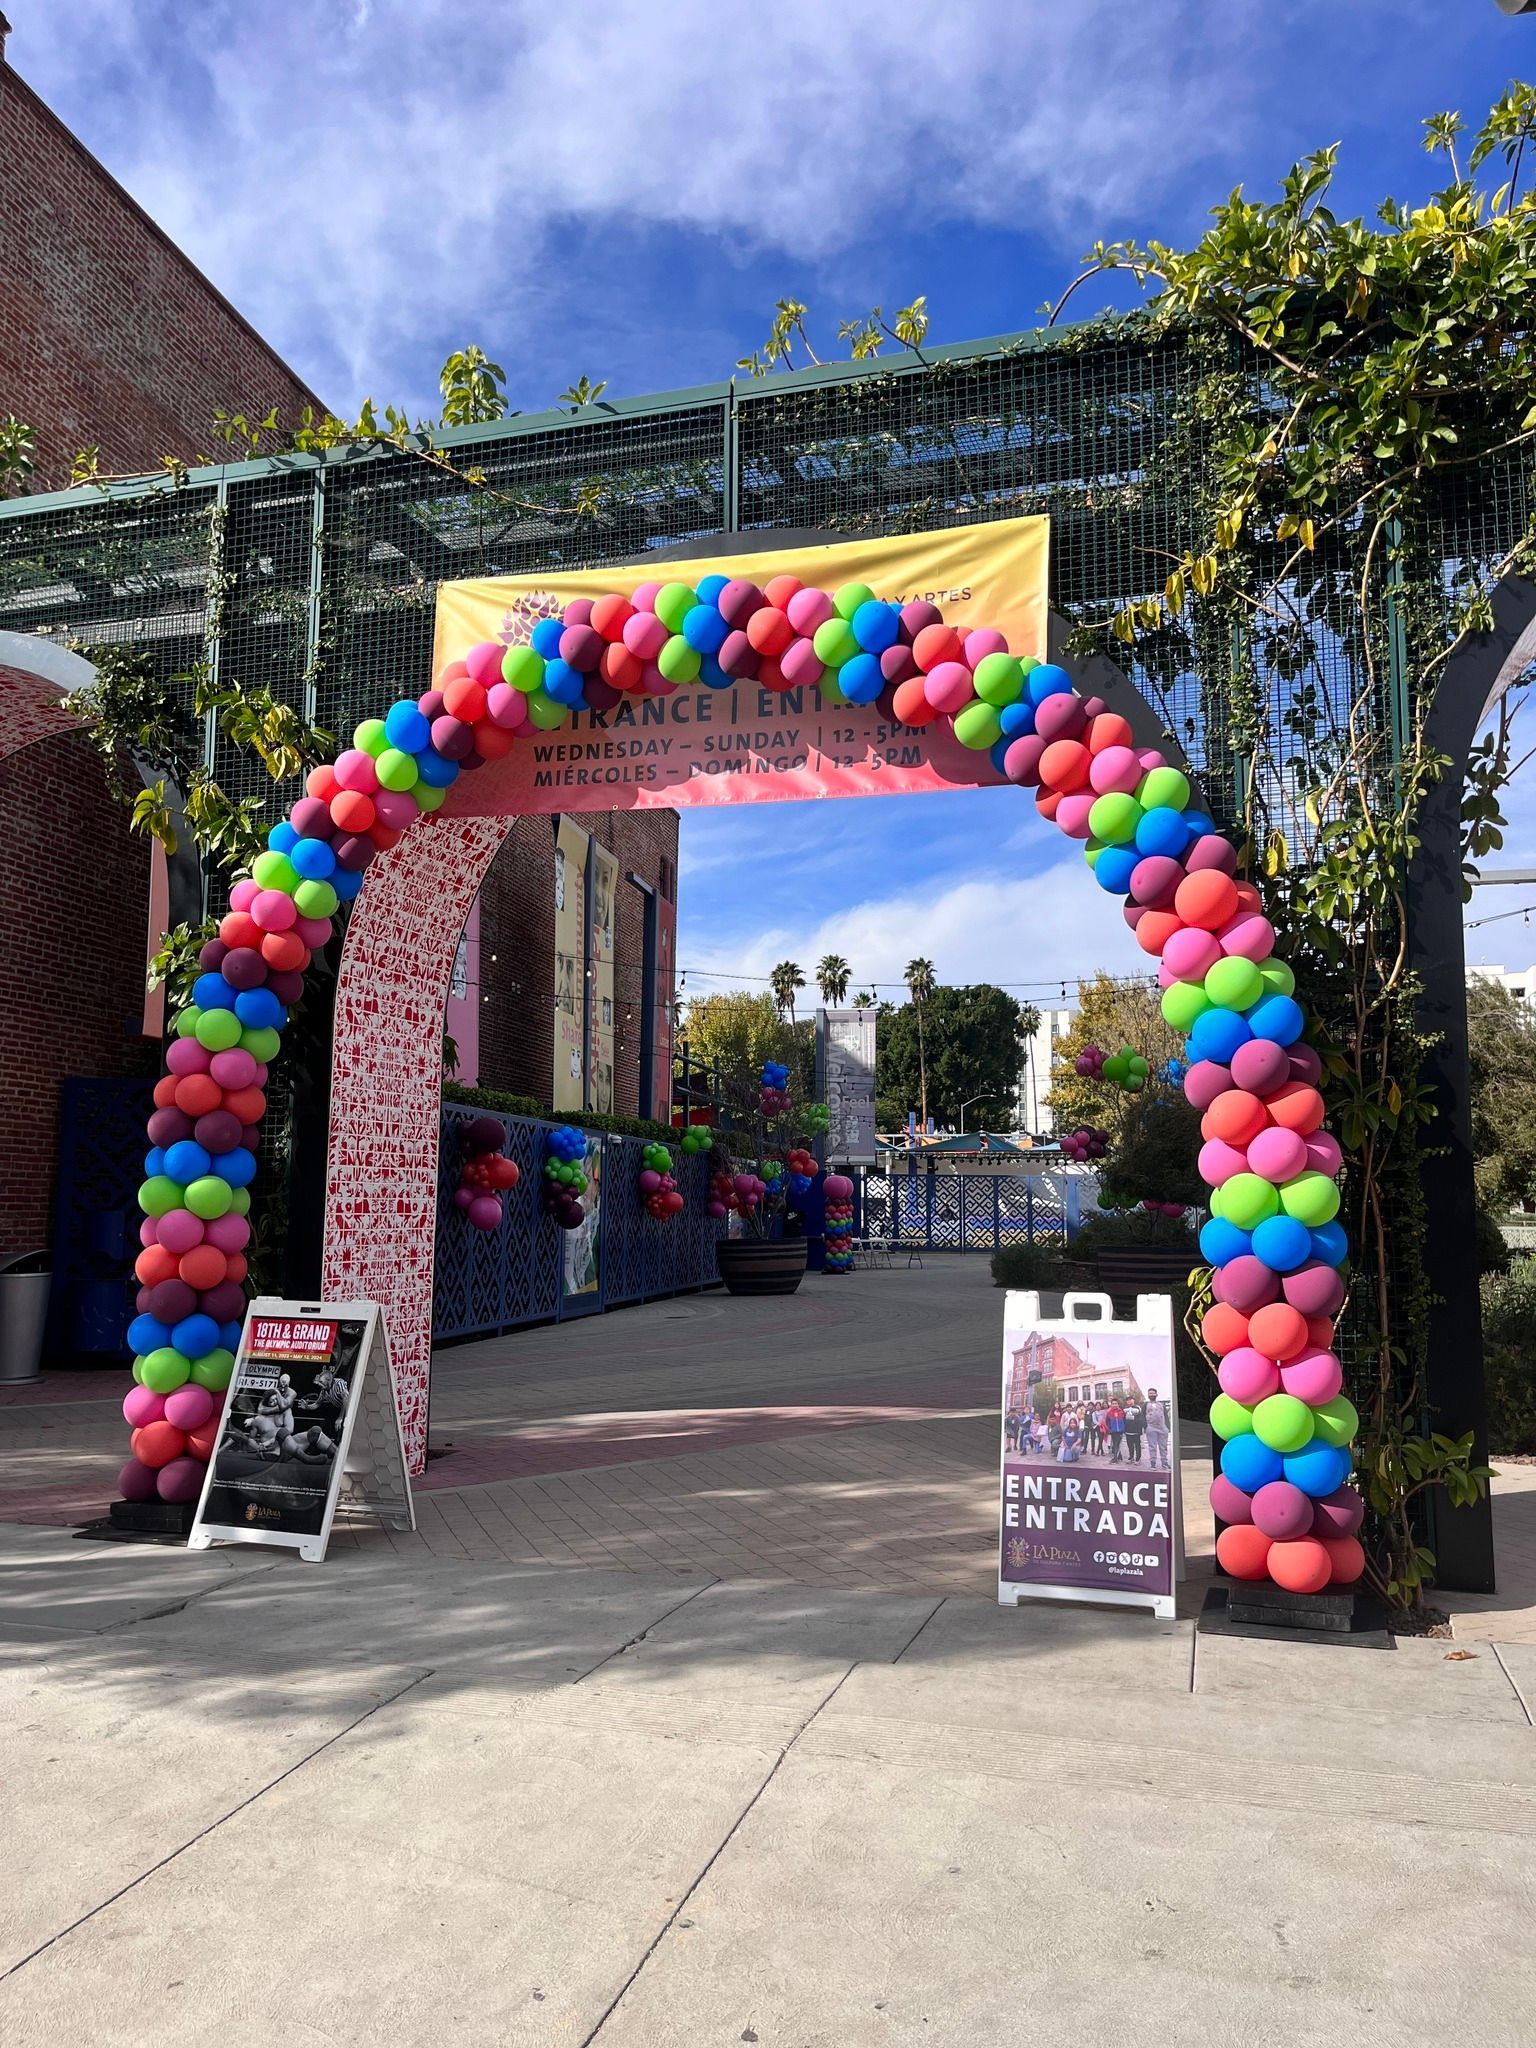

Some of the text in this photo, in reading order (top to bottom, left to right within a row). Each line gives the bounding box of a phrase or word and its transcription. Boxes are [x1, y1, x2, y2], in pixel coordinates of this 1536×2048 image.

[540, 693, 712, 731] TRANCE
[533, 738, 674, 763] WEDNESDAY
[704, 729, 800, 753] SUNDAY
[833, 729, 855, 744] 12
[877, 724, 926, 744] 5PM
[534, 764, 657, 787] MIÉRCOLES
[689, 753, 807, 779] DOMINGO
[833, 755, 854, 769] 12
[871, 746, 922, 771] 5PM
[573, 863, 584, 1028] Community
[561, 1020, 582, 1046] Share
[842, 1095, 870, 1108] Feel
[256, 1322, 331, 1341] 18TH & GRAND
[253, 1339, 328, 1351] THE OLYMPIC AUDITORIUM
[248, 1365, 280, 1375] OLYMPIC
[1005, 1474, 1168, 1508] ENTRANCE
[1005, 1503, 1170, 1539] ENTRADA
[1033, 1544, 1049, 1559] LA
[1108, 1567, 1144, 1576] @laplazala
